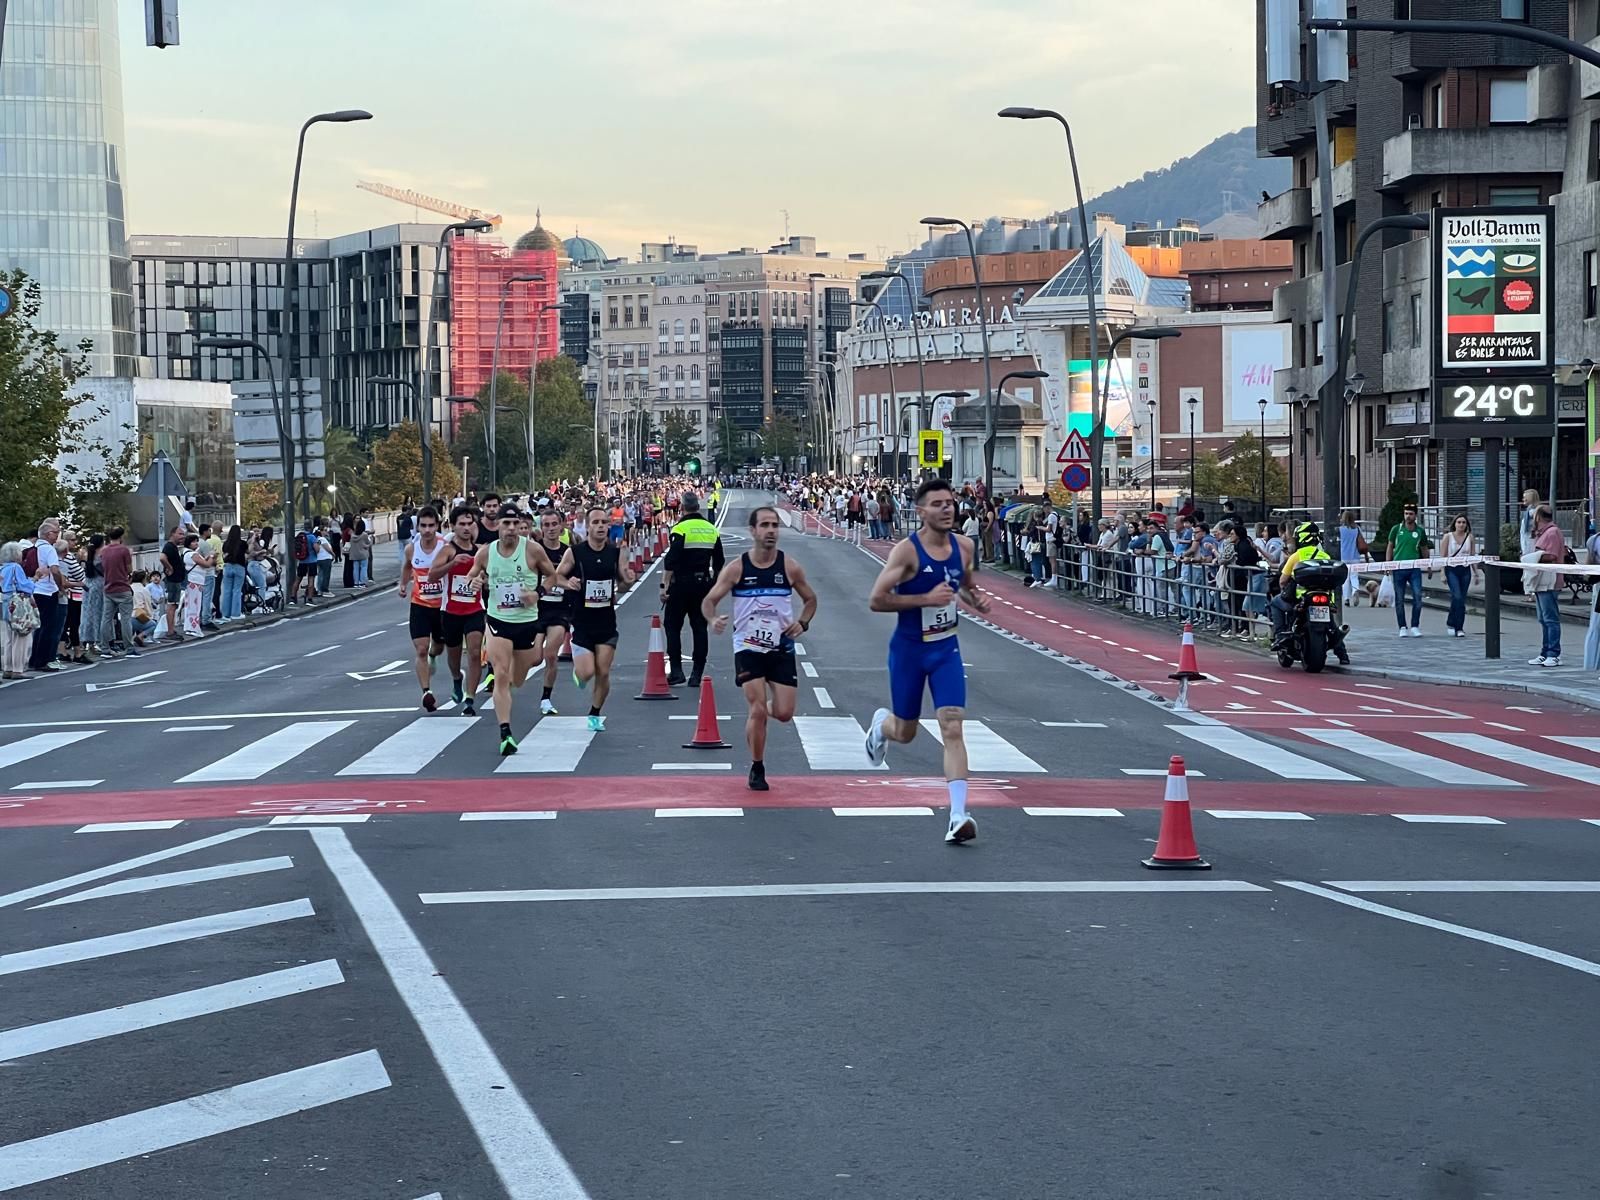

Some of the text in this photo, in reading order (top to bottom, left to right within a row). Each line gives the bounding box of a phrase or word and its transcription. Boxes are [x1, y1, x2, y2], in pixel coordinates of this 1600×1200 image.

[1447, 219, 1541, 238] Voll-Damm
[909, 304, 1015, 329] COMERCIA
[1459, 336, 1477, 348] SER
[1455, 346, 1535, 359] ES DOBLE O NADA
[1453, 384, 1534, 418] 24°C
[504, 593, 516, 602] 93
[935, 611, 948, 624] 51
[755, 629, 773, 641] 112
